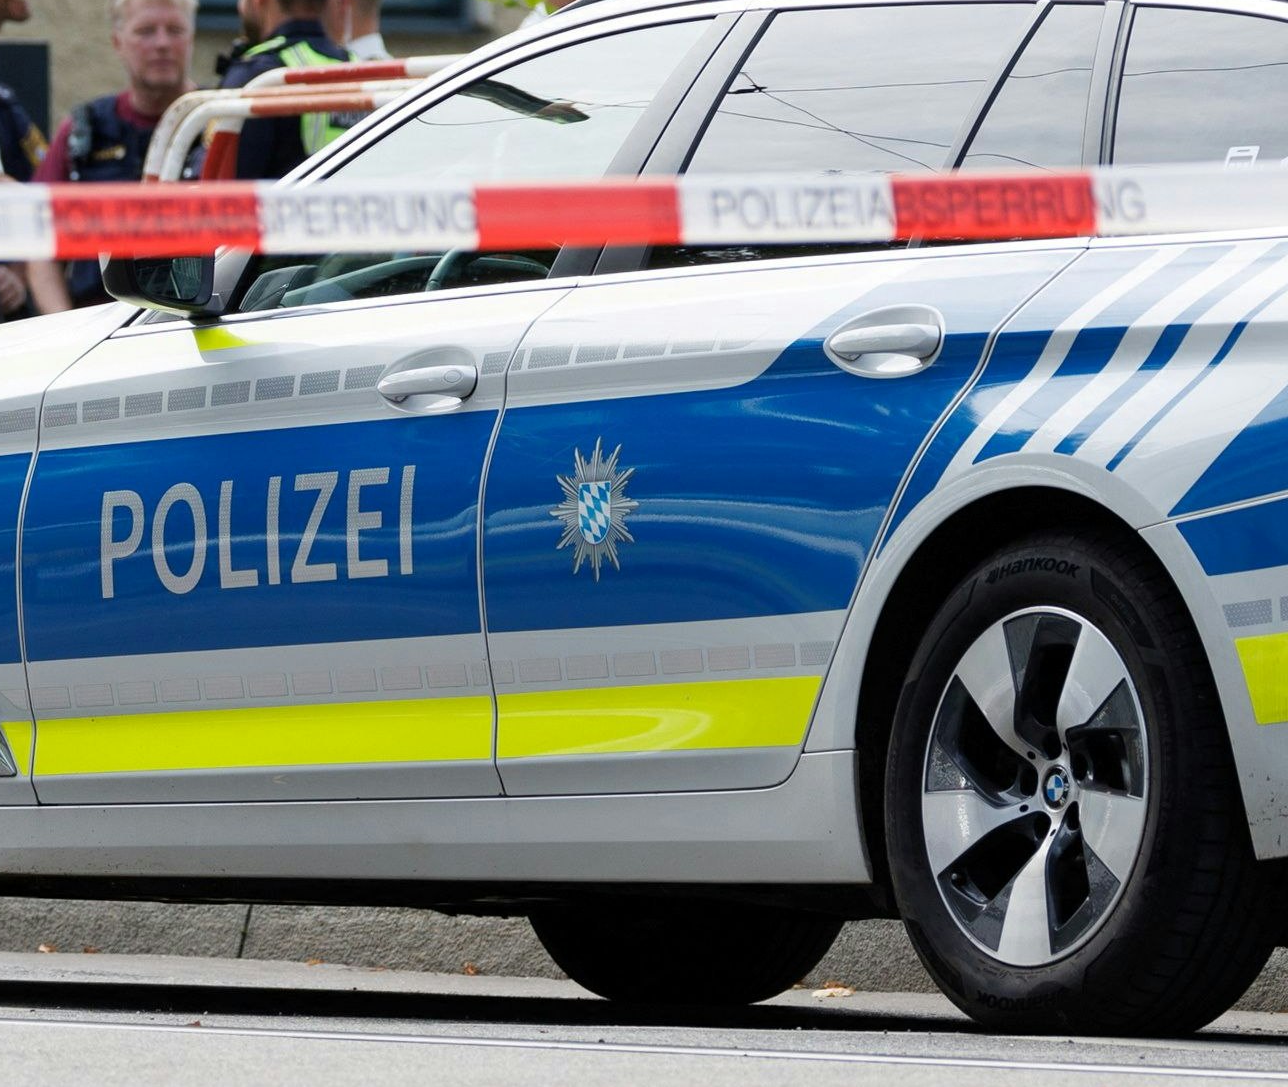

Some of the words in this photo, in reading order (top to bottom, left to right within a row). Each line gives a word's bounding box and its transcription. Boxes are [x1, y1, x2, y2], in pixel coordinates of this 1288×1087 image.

[35, 193, 475, 238] POLIZEIABSPERRUNG
[710, 182, 1146, 231] POLIZEIABSPERRUNG
[100, 465, 416, 599] POLIZEI
